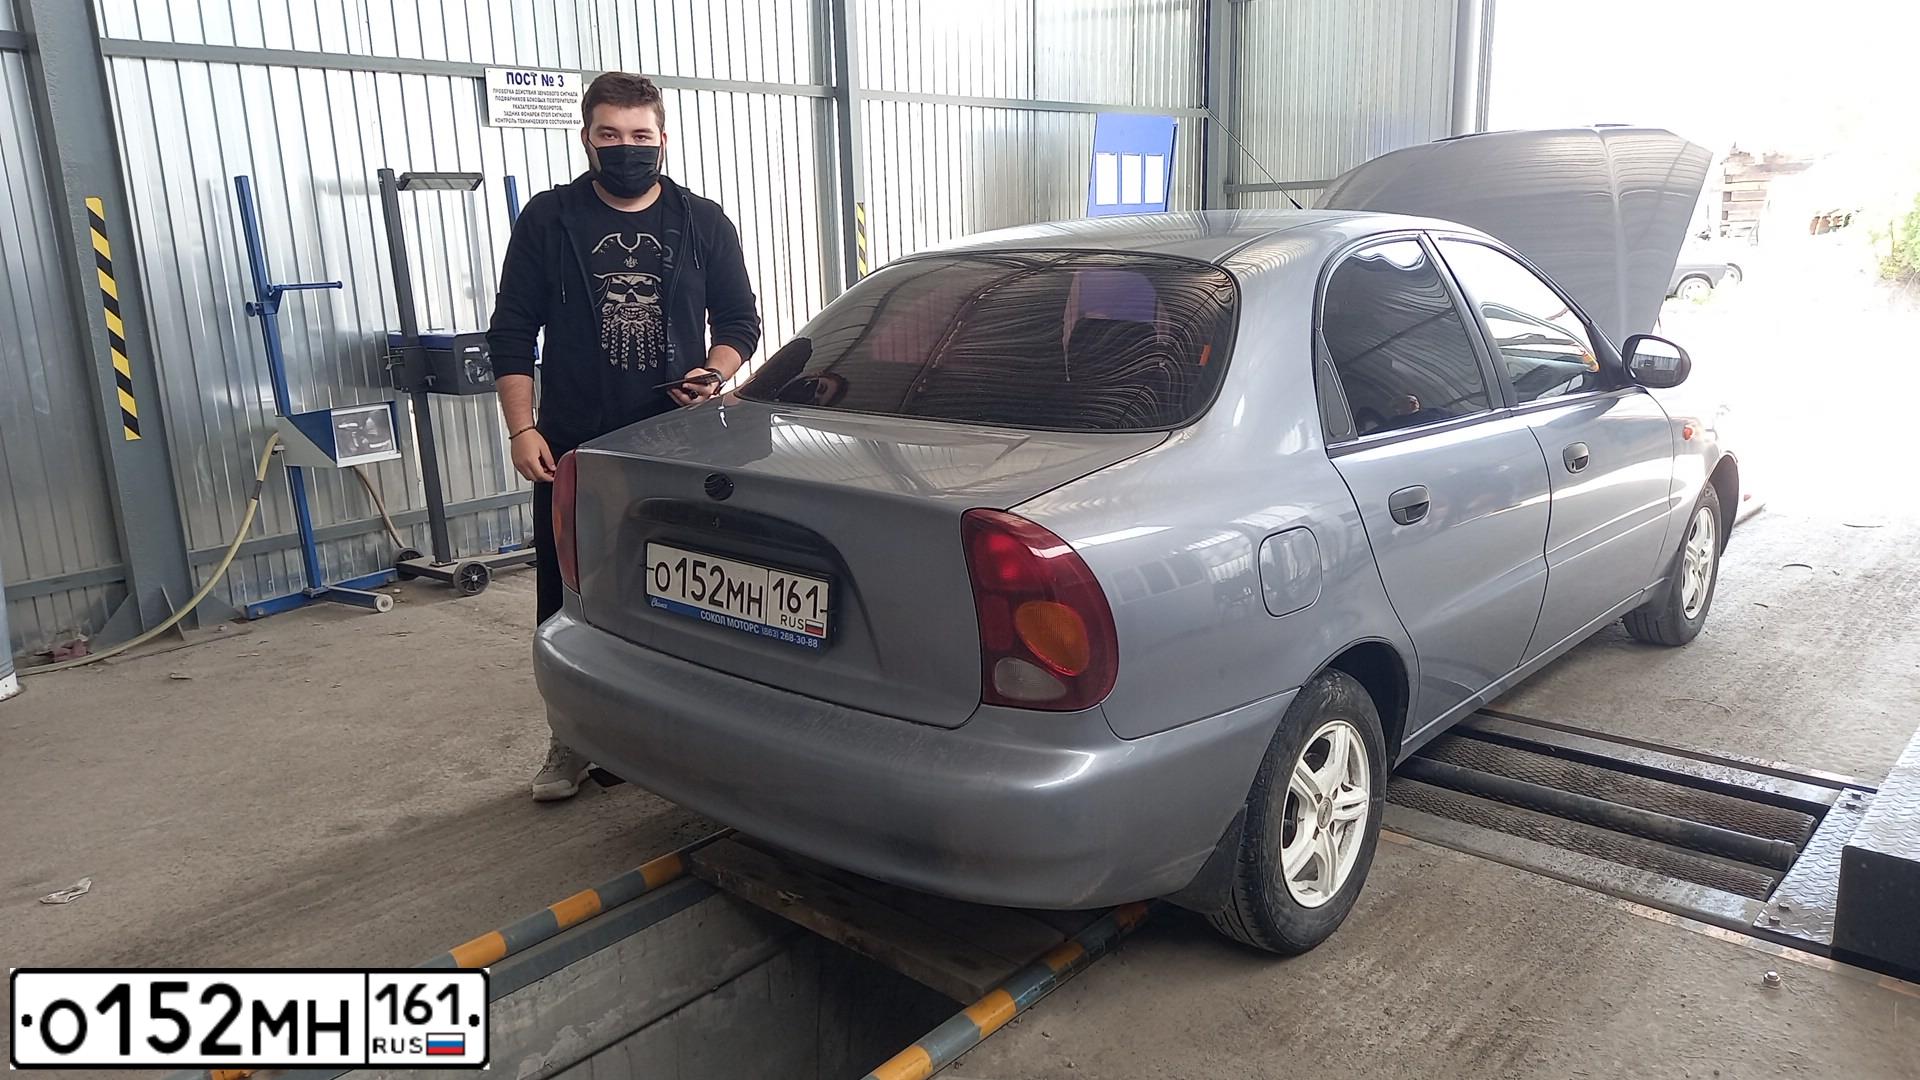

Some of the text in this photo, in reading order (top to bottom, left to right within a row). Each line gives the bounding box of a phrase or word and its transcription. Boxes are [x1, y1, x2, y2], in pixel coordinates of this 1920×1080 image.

[506, 72, 564, 88] ПОСТ № 3
[772, 577, 819, 619] 161
[700, 610, 726, 626] СОКОЛ
[727, 617, 759, 634] МОТОРС
[780, 614, 804, 630] RUS
